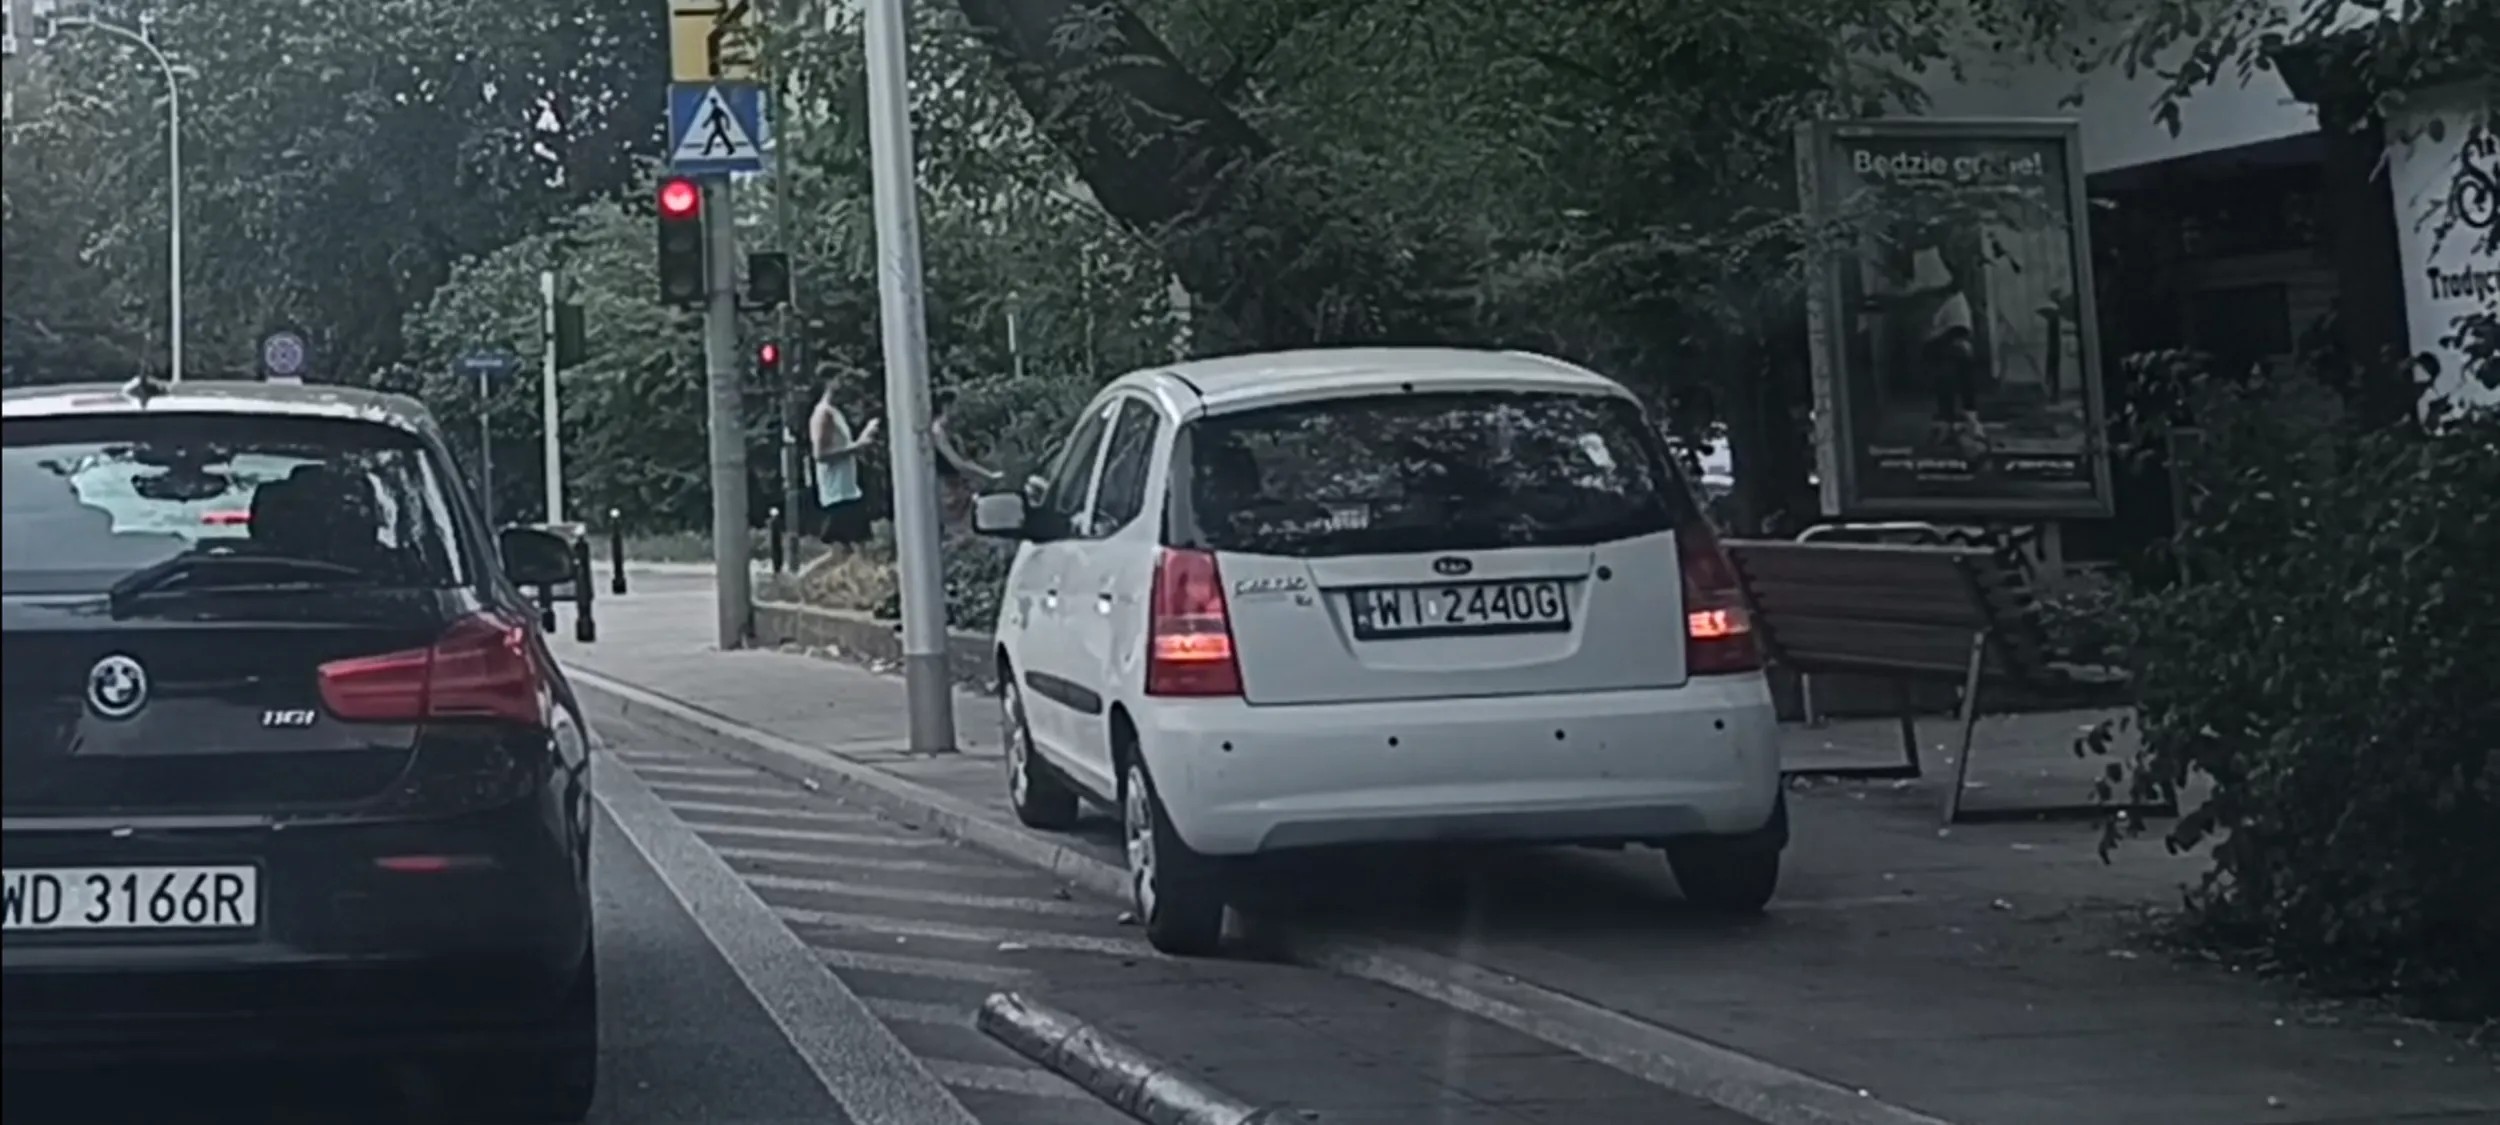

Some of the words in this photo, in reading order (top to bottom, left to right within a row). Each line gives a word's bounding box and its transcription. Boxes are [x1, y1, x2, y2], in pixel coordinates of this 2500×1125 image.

[1854, 149, 1947, 179] Będzie
[2426, 263, 2500, 302] Tradyc
[1376, 588, 1423, 625] WI
[1441, 584, 1559, 623] 2440G
[2, 874, 61, 924] WD
[85, 872, 244, 924] 3166R
